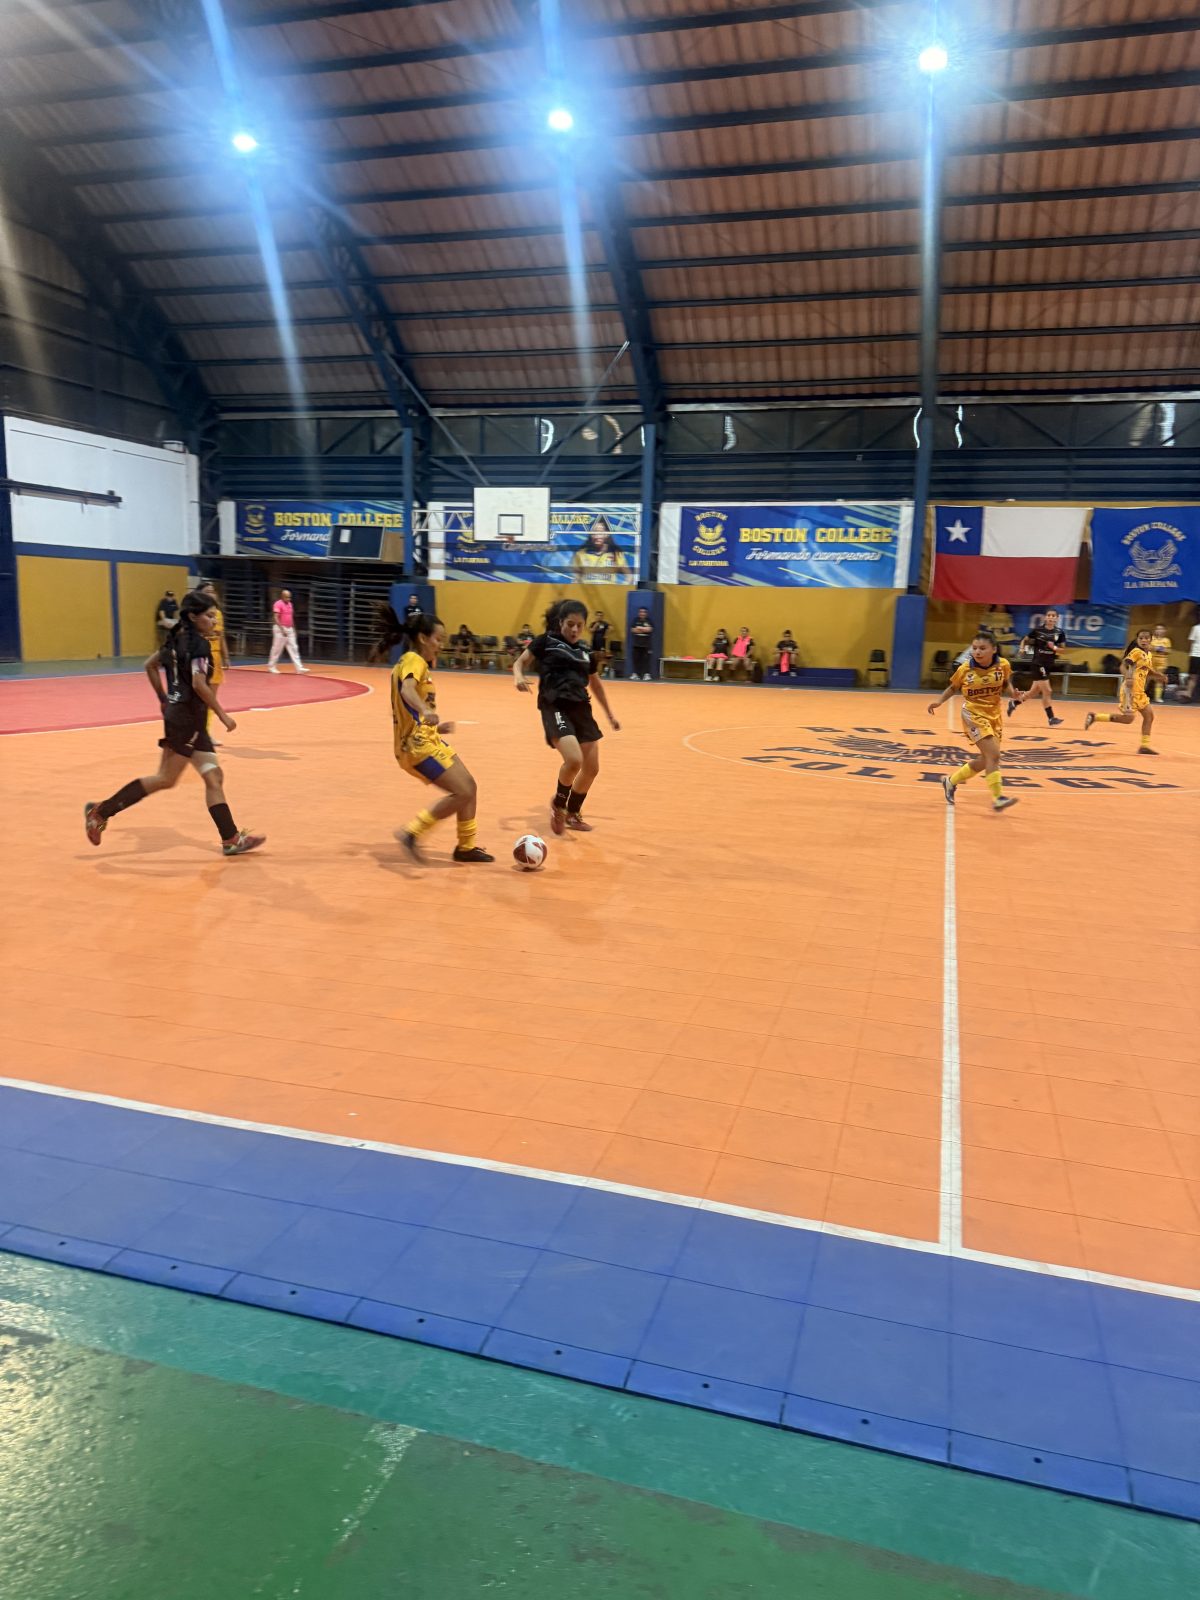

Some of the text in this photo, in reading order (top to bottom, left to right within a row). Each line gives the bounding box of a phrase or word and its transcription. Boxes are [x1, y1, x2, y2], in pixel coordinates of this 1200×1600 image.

[274, 512, 404, 528] BOSTON COLLEGE
[738, 527, 894, 544] BOSTON COLLEGE
[797, 725, 1116, 747] BOSON
